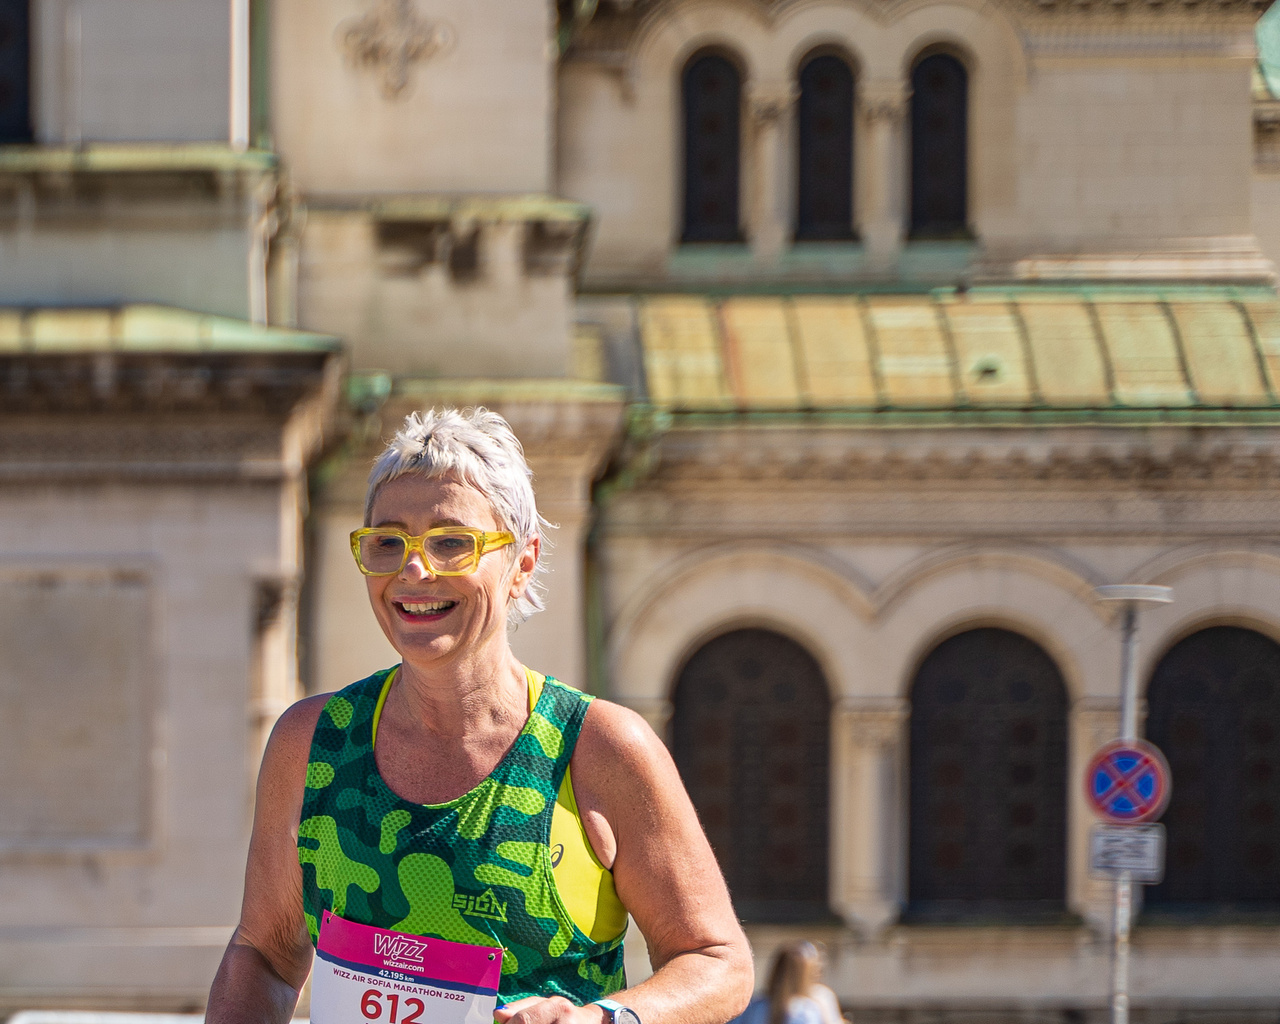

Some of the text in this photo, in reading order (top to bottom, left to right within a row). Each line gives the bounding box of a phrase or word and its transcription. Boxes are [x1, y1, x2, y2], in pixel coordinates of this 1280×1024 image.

[383, 959, 425, 973] wizzair.com
[378, 969, 415, 983] 42.195 km
[333, 967, 466, 1002] WIZZ AIR SOFIA MARATHON 2022
